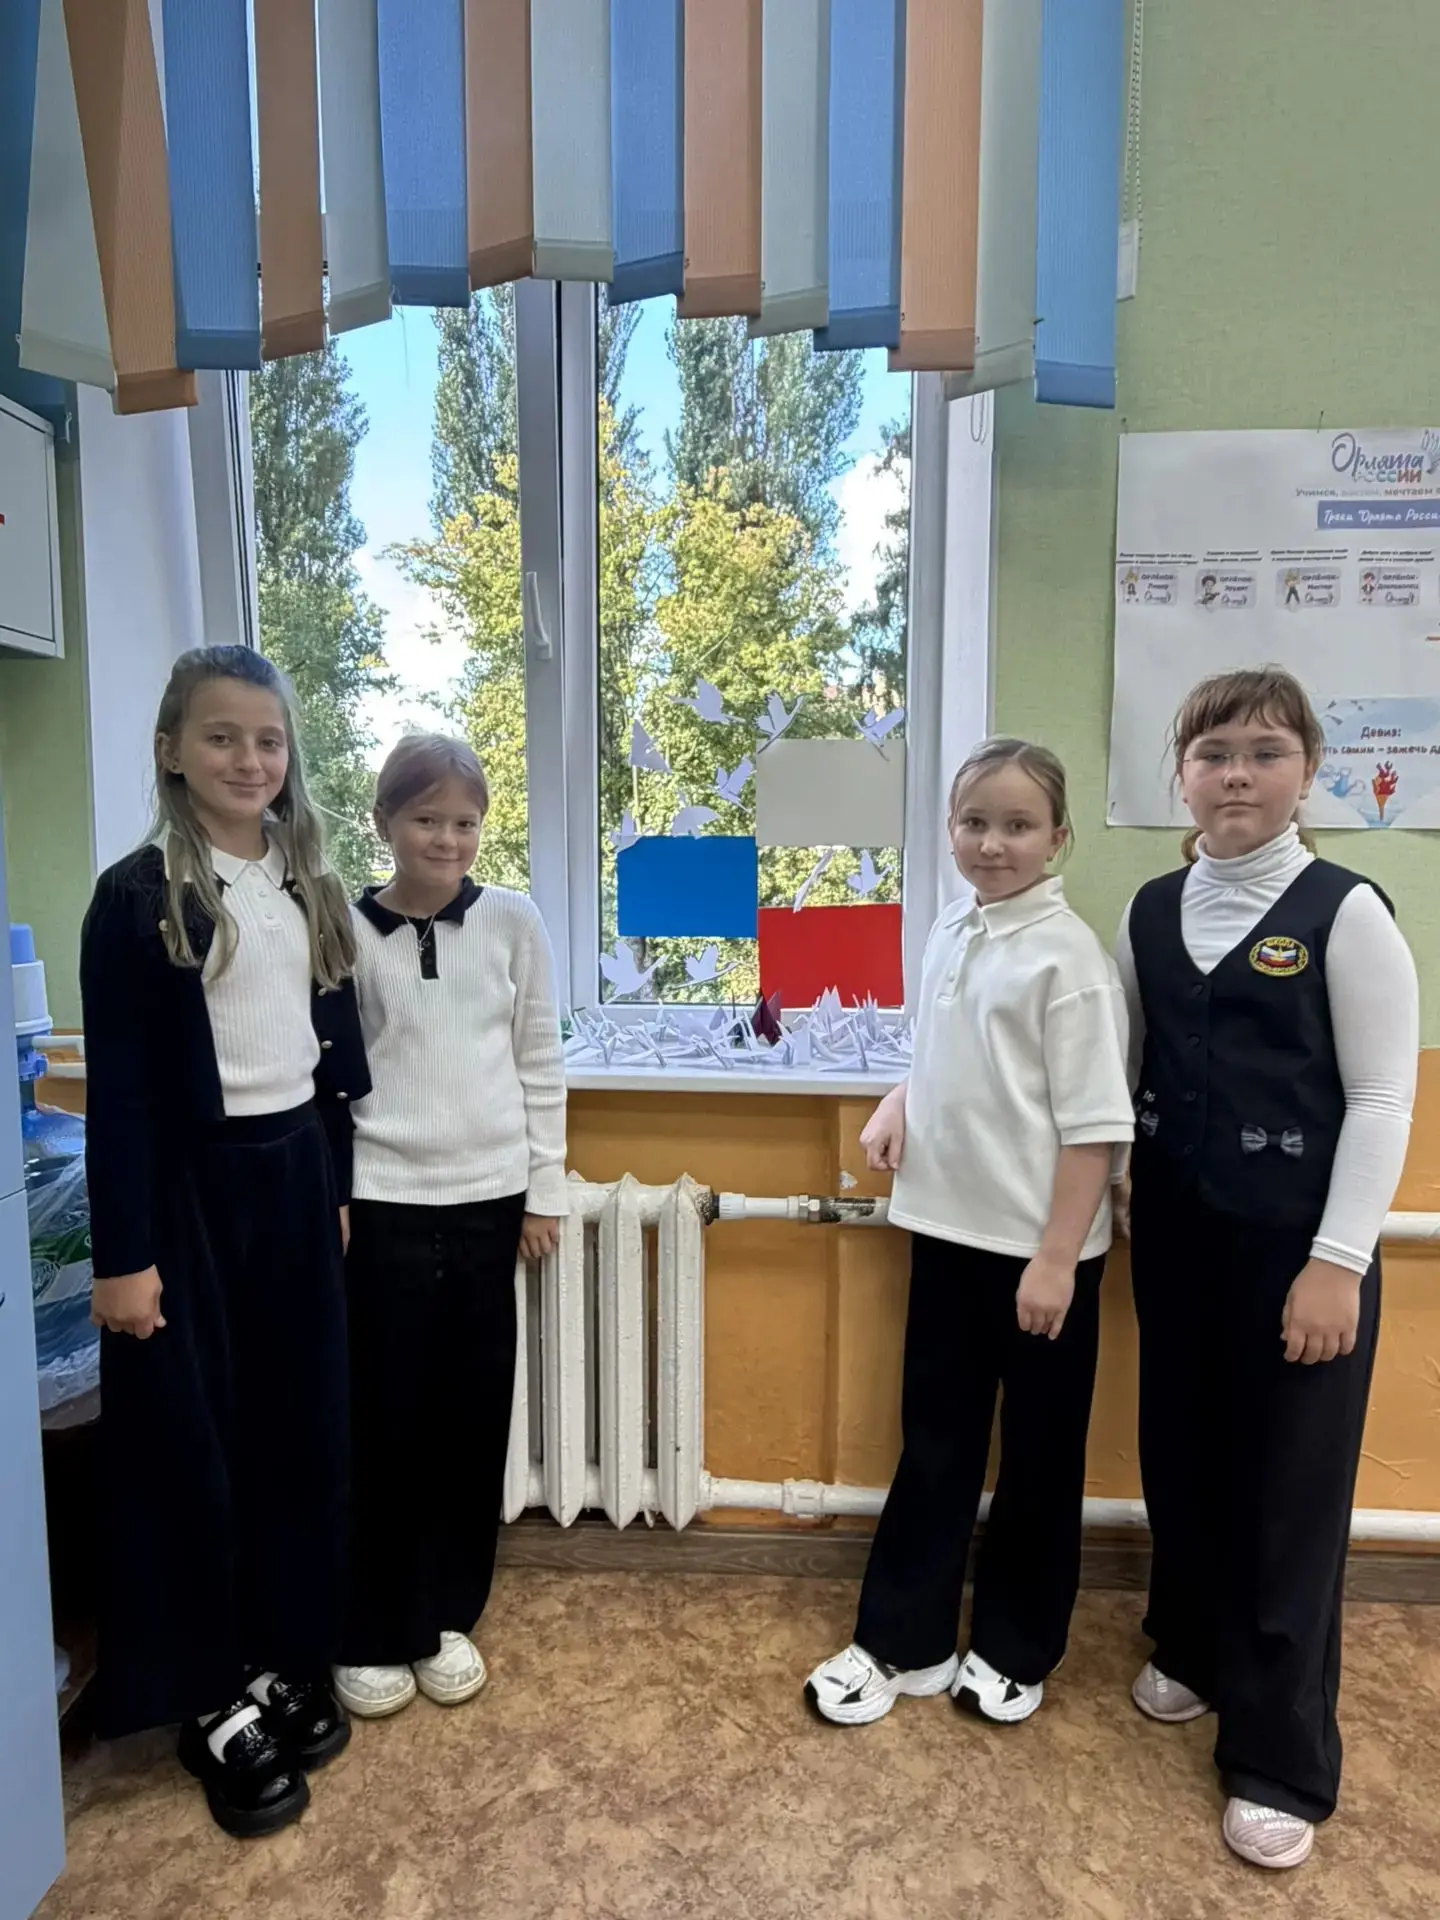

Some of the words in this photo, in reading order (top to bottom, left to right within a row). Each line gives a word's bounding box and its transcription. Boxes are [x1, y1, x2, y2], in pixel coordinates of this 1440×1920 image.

[1332, 432, 1424, 477] Орлята
[1405, 508, 1440, 522] Росси
[1360, 725, 1402, 740] Девиз:
[1341, 745, 1375, 755] самим
